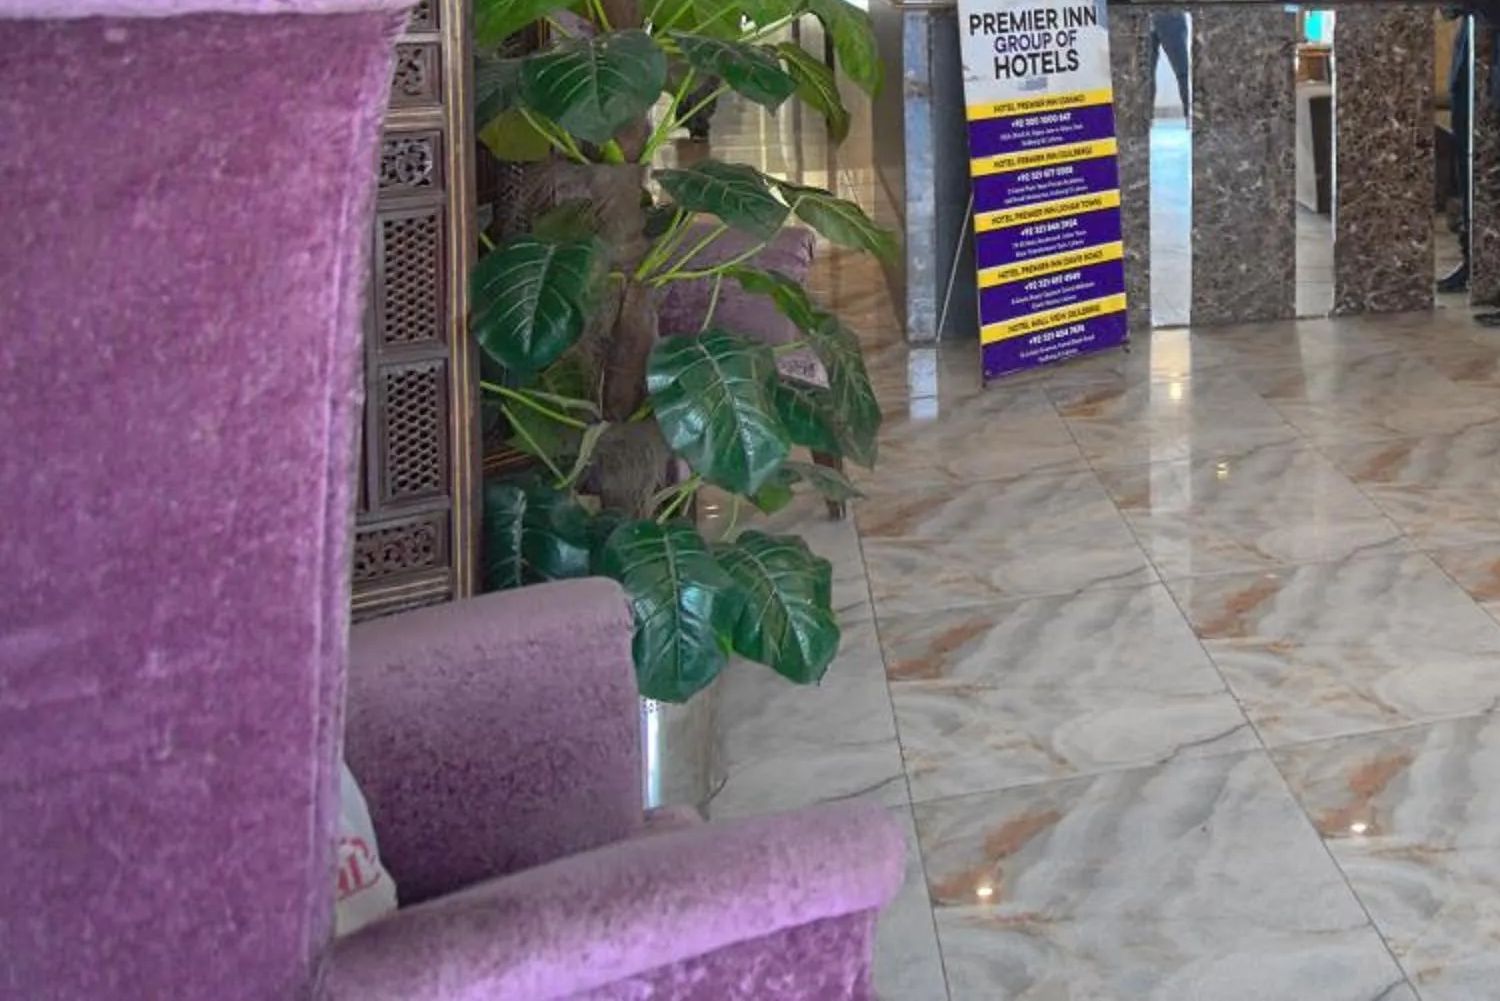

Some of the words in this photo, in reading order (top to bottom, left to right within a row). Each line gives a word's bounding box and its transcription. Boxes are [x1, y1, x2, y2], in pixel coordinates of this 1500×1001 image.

[968, 8, 1059, 36] PREMIER
[1063, 5, 1097, 28] INN
[993, 33, 1052, 54] GROUP
[1056, 30, 1077, 48] OF
[994, 49, 1080, 80] HOTELS
